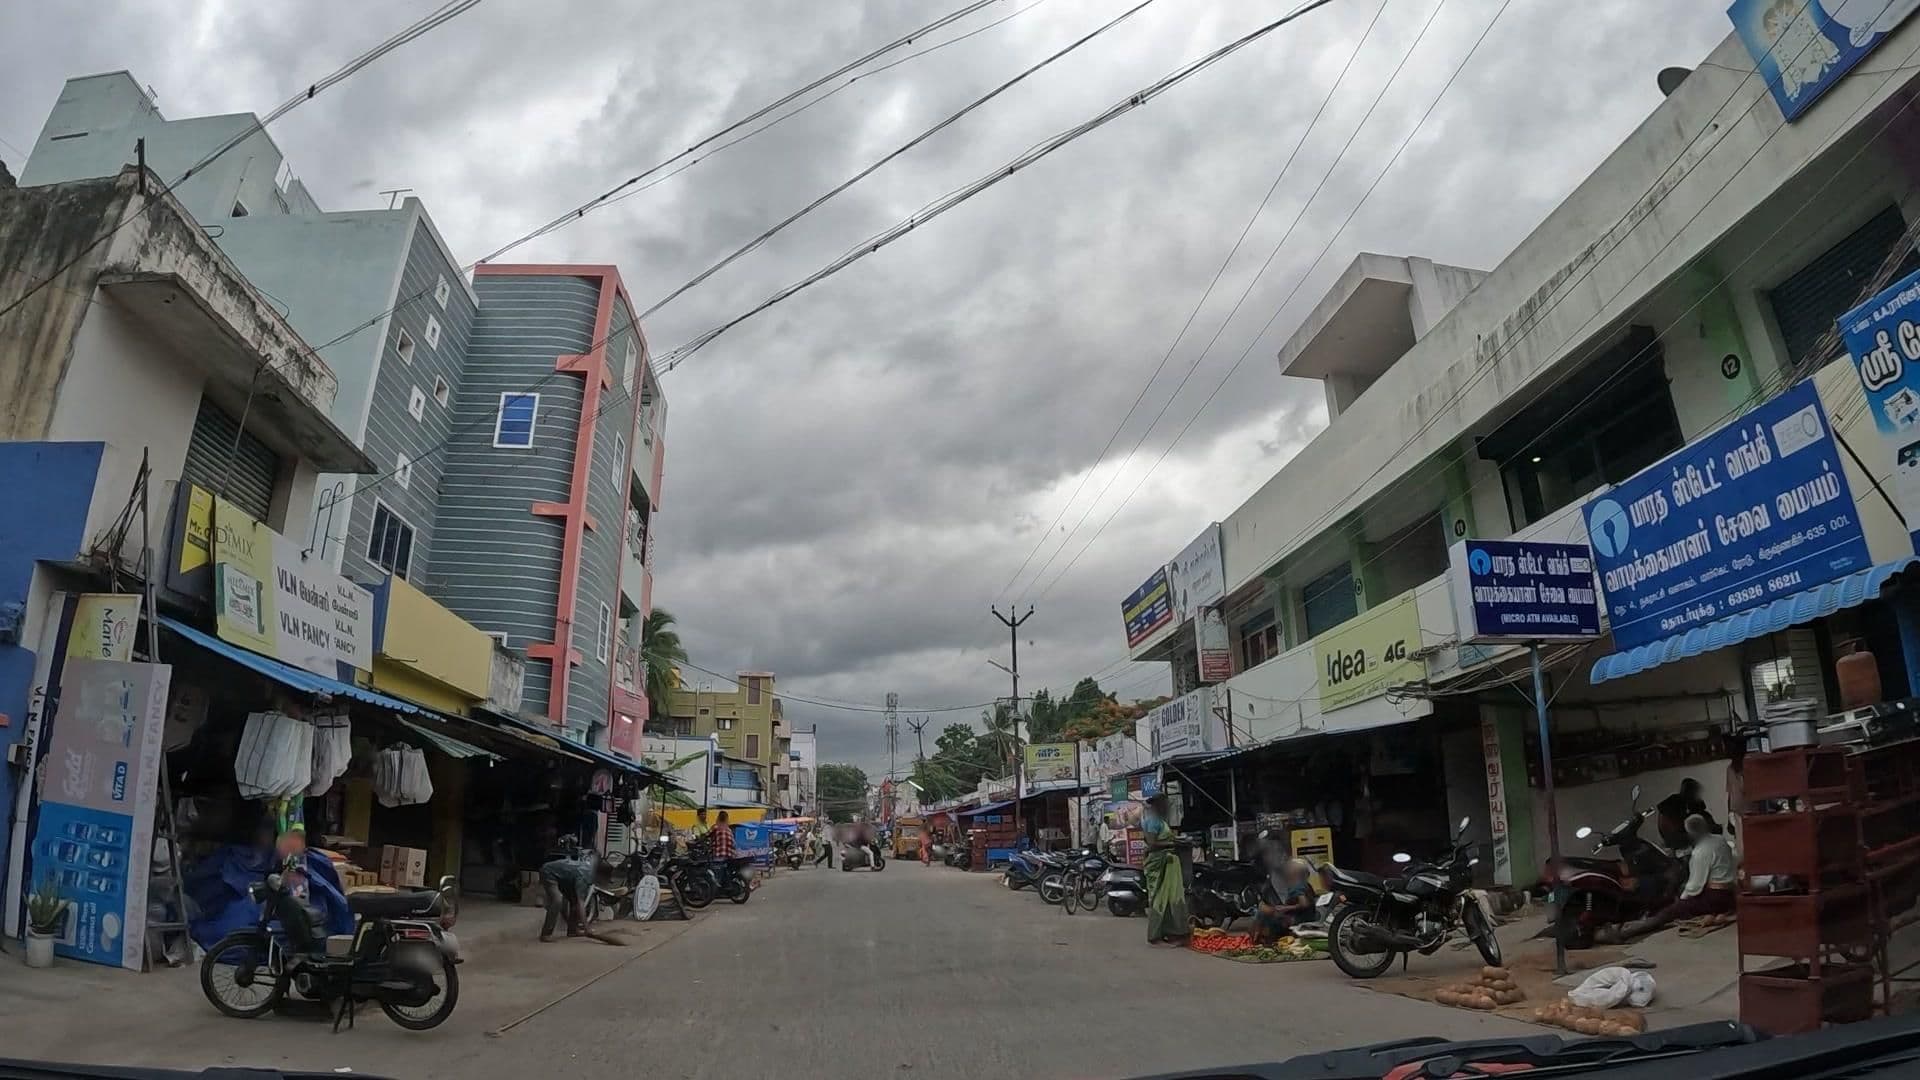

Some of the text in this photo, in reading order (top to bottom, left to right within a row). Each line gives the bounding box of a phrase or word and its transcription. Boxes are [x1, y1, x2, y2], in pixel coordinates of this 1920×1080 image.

[1723, 359, 1738, 376] 12
[1629, 486, 1669, 528] பாரத
[1724, 423, 1772, 480] வங்கி
[1605, 459, 1841, 593] வாடிக்கையாளர் சேவை மையம்
[277, 566, 298, 597] VLN
[1539, 582, 1566, 604] சேவை
[1728, 584, 1764, 607] 63826
[1767, 570, 1802, 593] 86211
[101, 607, 115, 658] Marie
[279, 611, 330, 649] VLN FANCY
[1500, 613, 1579, 625] (MICRO ATM AVAILABLE)
[1383, 639, 1406, 664] 4G
[1161, 702, 1186, 728] GOLDEN
[113, 776, 125, 800] VITA
